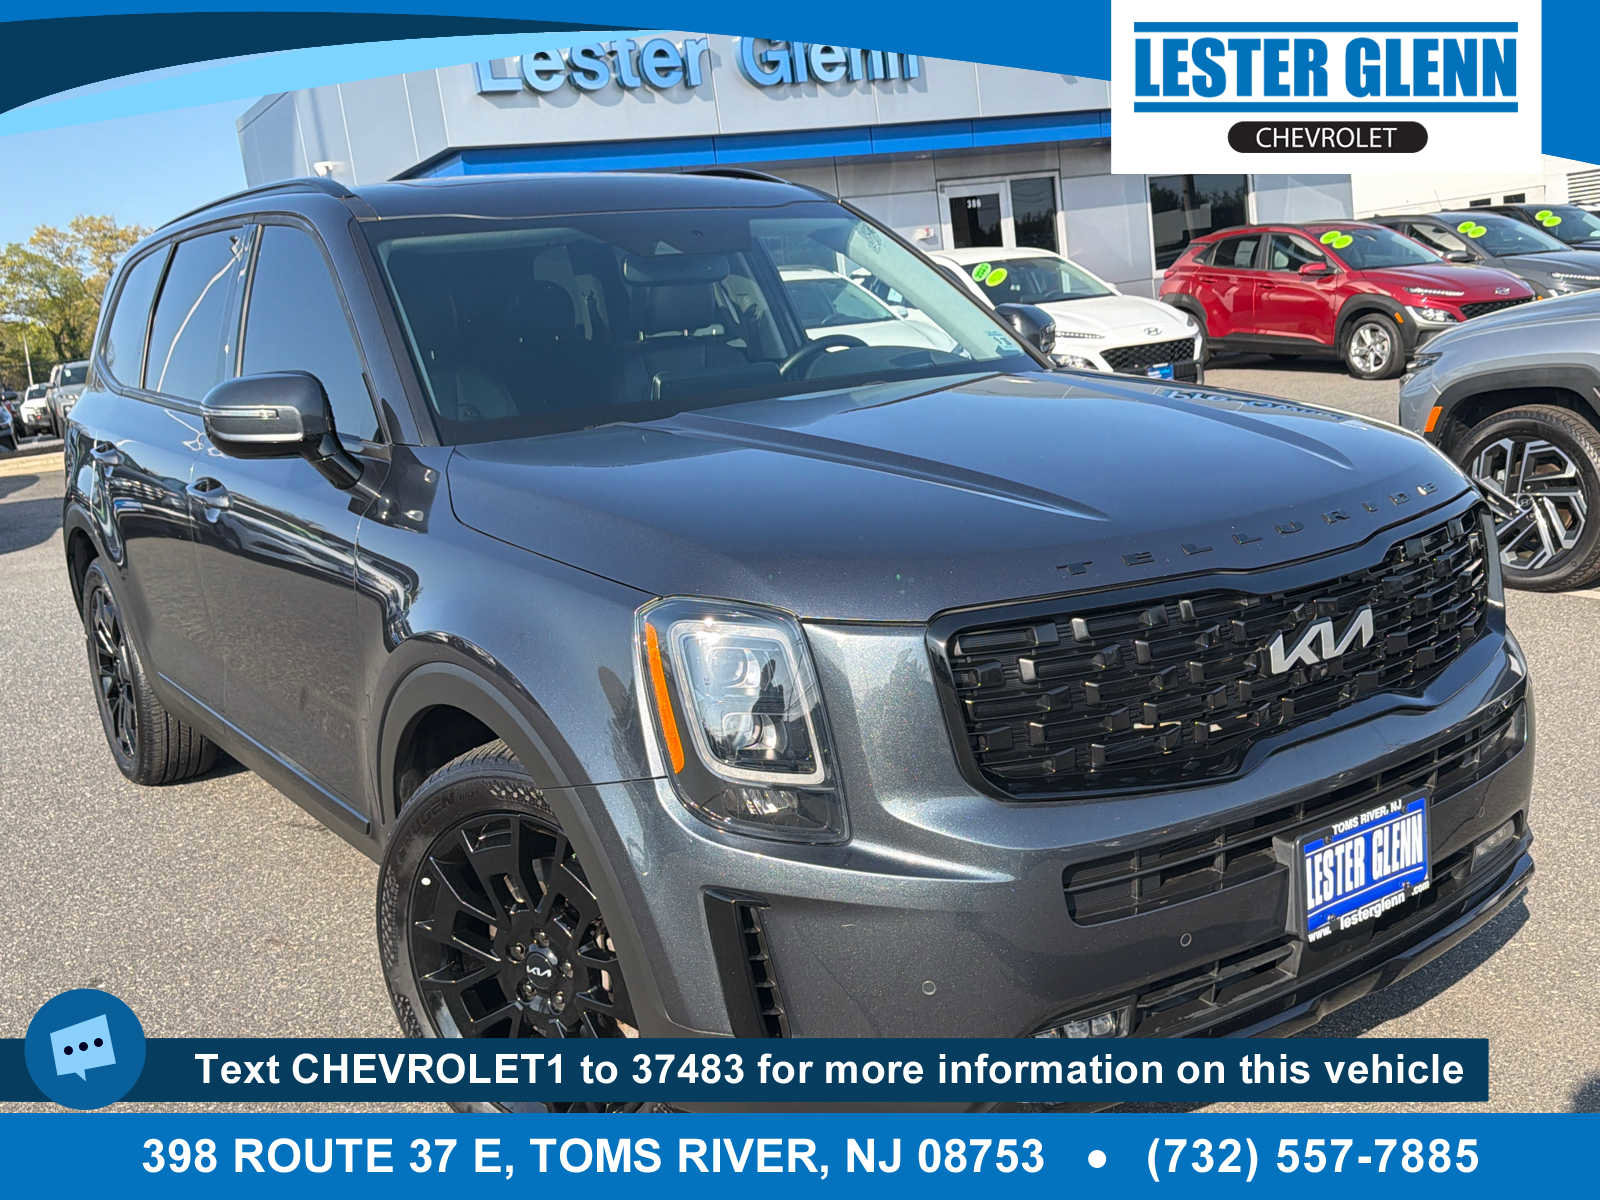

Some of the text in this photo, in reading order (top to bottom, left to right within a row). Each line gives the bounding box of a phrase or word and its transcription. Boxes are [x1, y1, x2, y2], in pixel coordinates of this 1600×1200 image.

[474, 37, 709, 95] Lester
[1055, 481, 1438, 576] TELLURIDE
[1331, 799, 1402, 835] TOMS RIVER, NJ
[1305, 813, 1424, 911] LESTER GLENN
